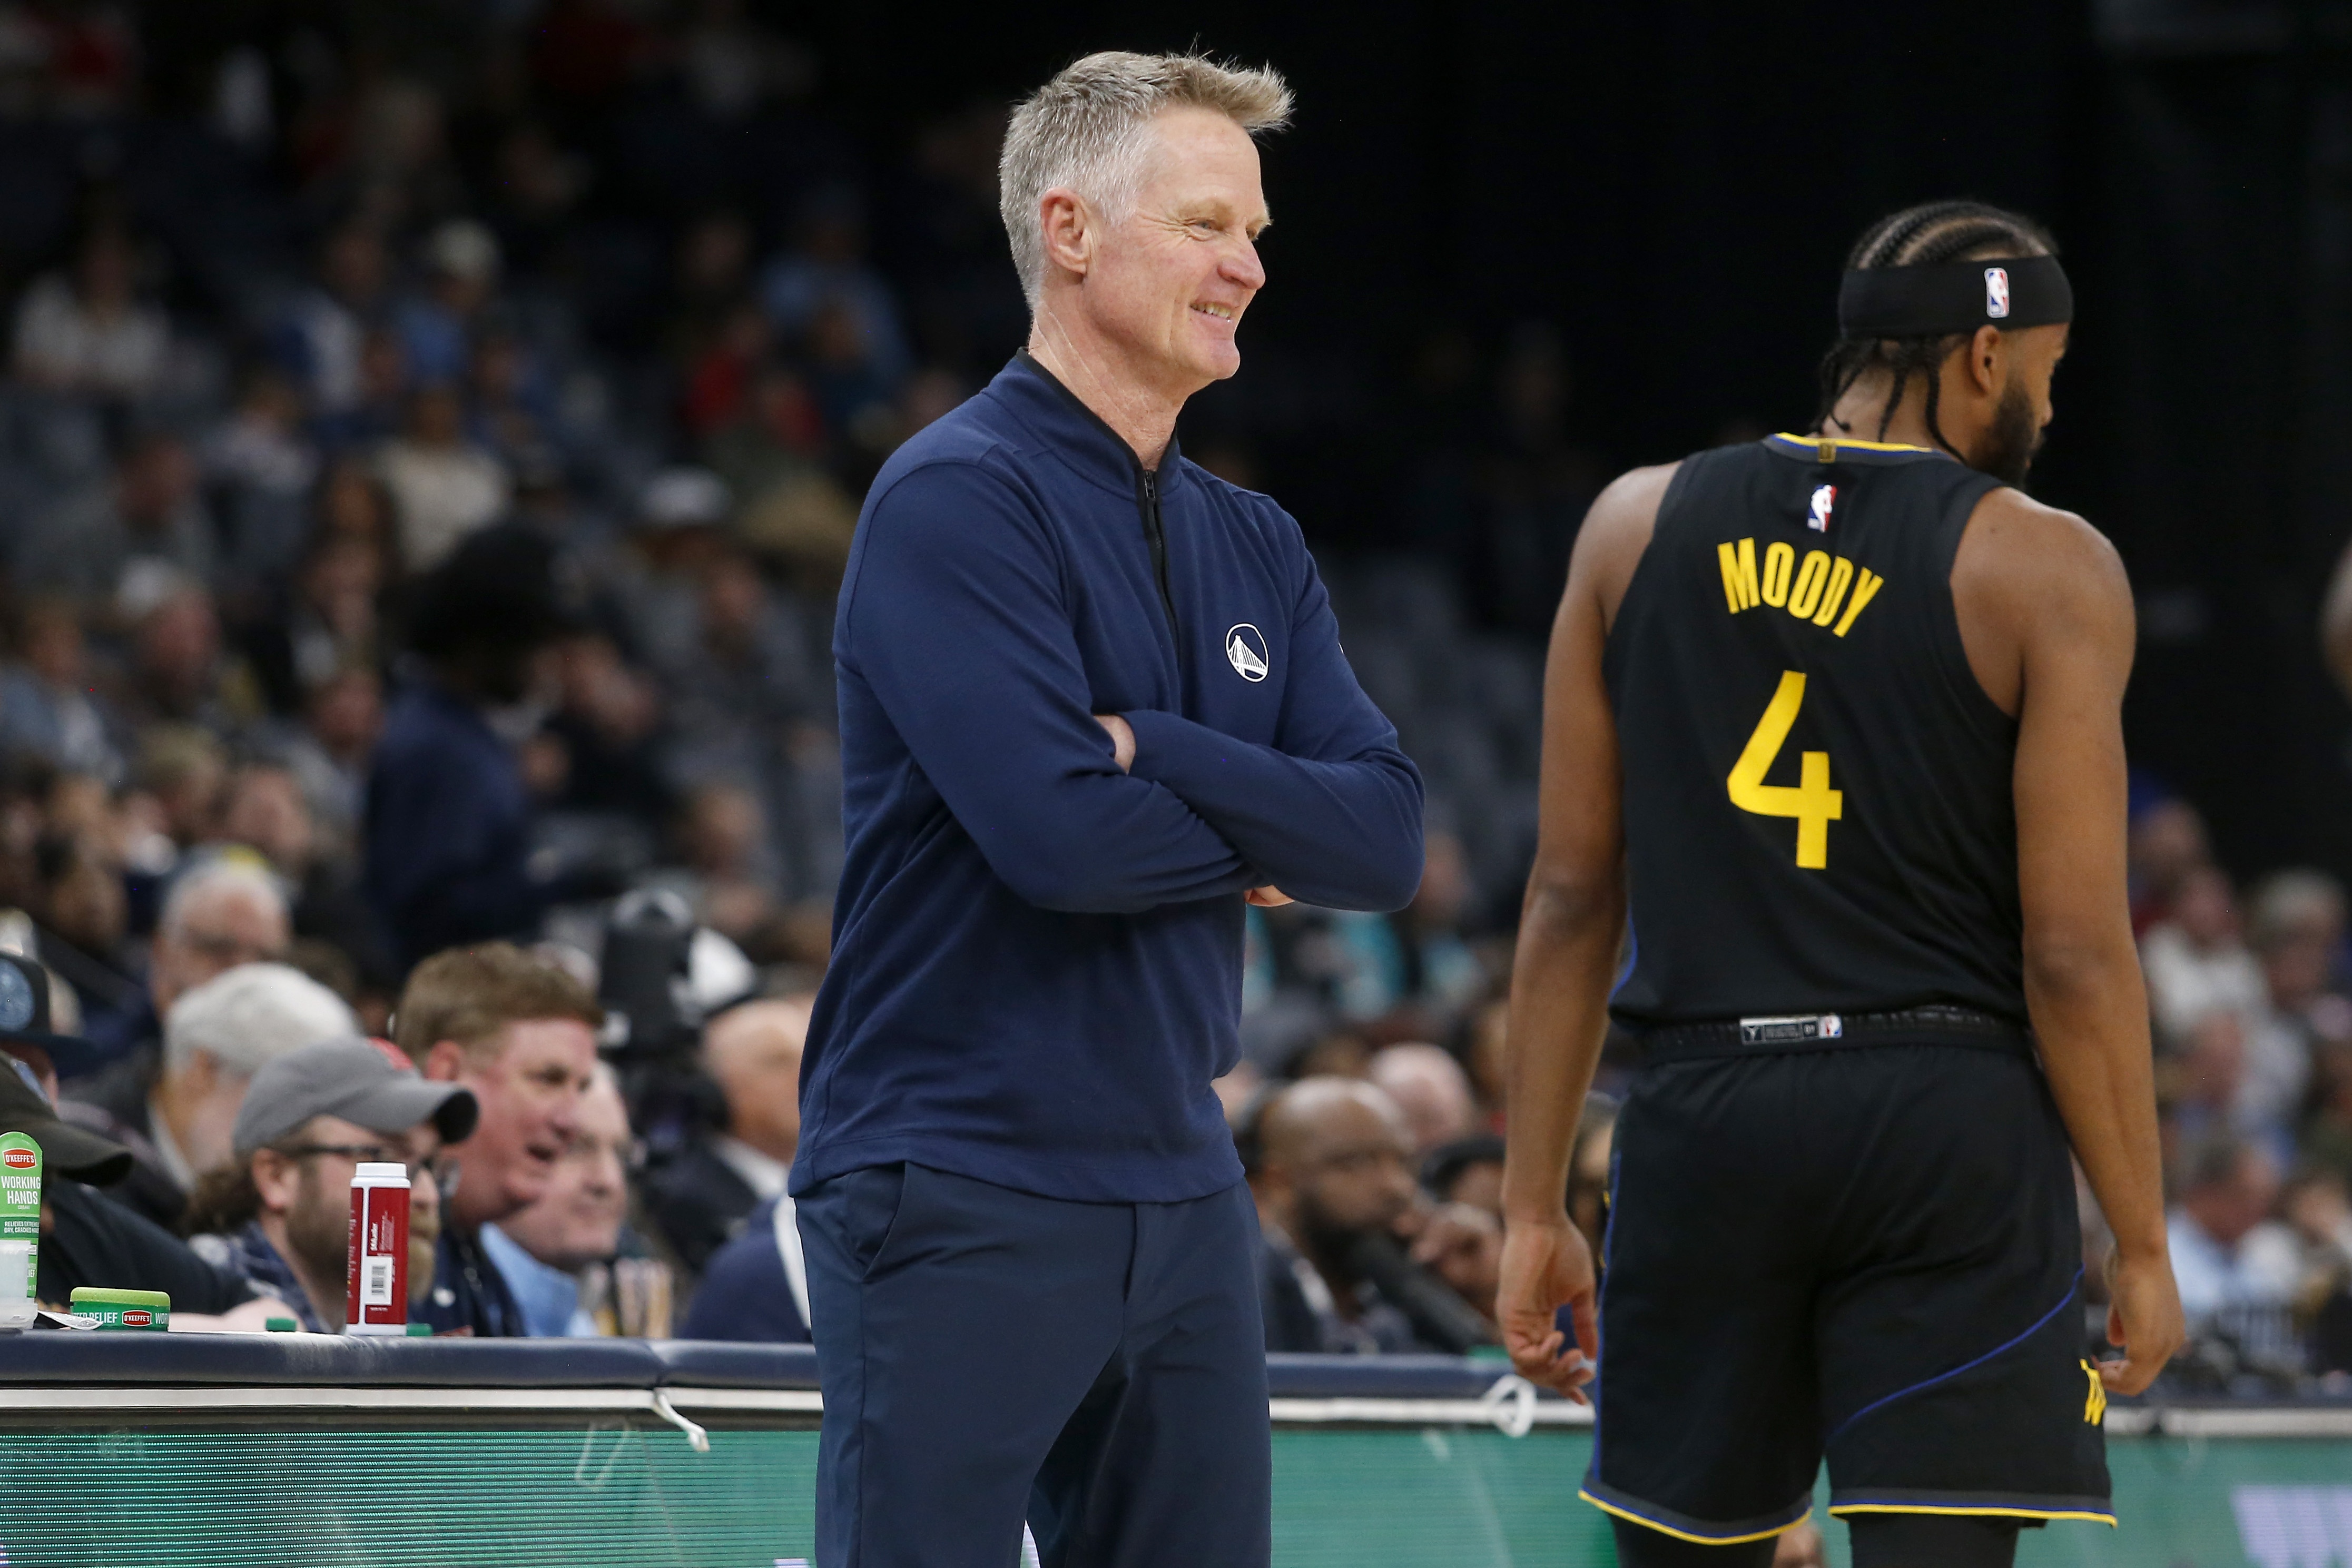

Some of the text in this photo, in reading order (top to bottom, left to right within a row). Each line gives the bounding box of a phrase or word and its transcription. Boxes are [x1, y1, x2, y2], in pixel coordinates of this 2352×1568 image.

[1717, 538, 1884, 637] MOODY
[1727, 670, 1842, 869] 4
[5, 1155, 34, 1163] O'KEEFFE'S
[1, 1176, 41, 1189] WORKING
[7, 1190, 38, 1205] HANDS
